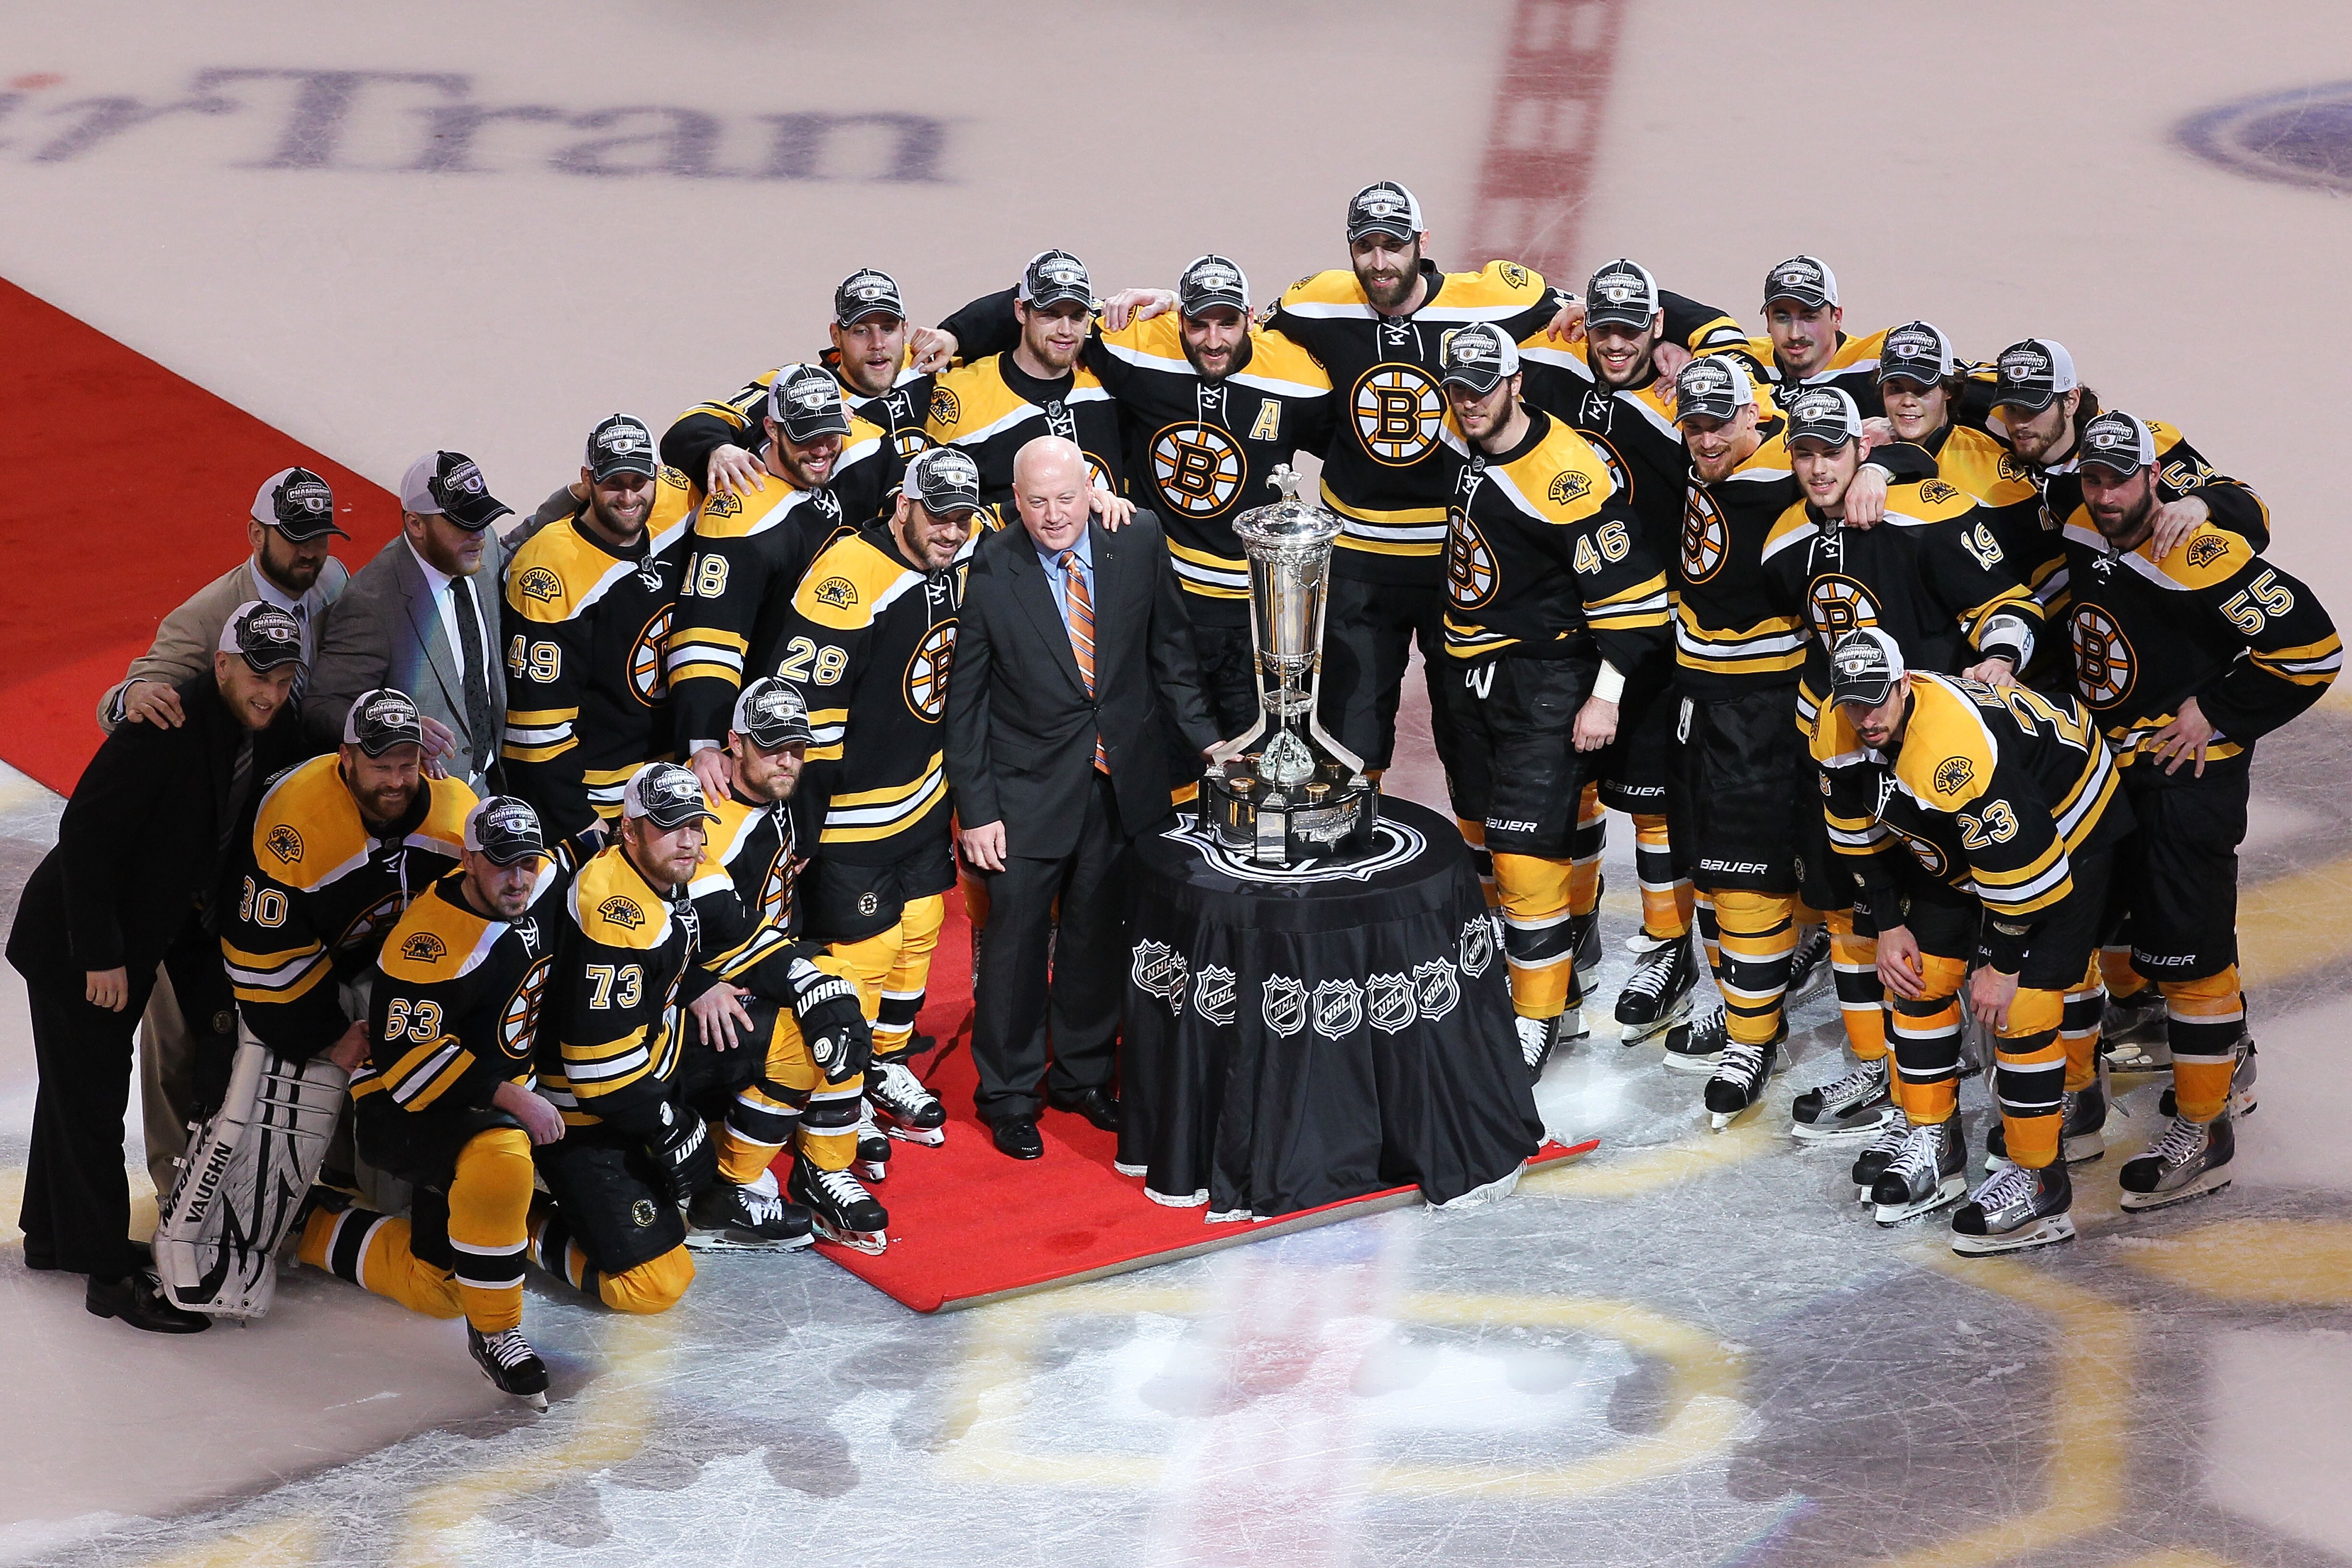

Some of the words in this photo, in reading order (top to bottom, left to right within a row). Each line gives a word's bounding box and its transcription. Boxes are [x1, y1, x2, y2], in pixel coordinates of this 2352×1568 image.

[1359, 196, 1404, 206] CHAMPIONS
[1041, 264, 1084, 275] CHAMPIONS
[1192, 270, 1236, 280] CHAMPIONS
[847, 282, 892, 293] CHAMPIONS
[1598, 280, 1642, 289] CHAMPIONS
[1452, 340, 1494, 349] CHAMPIONS
[1890, 336, 1933, 346] CHAMPIONS
[2003, 357, 2045, 367] CHAMPIONS
[1683, 372, 1725, 384] CHAMPIONS
[790, 384, 833, 398] CHAMPIONS
[933, 391, 956, 417] BRUINS
[1794, 399, 1837, 412] CHAMPIONS
[1249, 398, 1282, 441] A
[1375, 387, 1421, 444] B
[600, 432, 644, 443] CHAMPIONS
[2087, 426, 2131, 436] CHAMPIONS
[1168, 440, 1221, 499] B
[1553, 474, 1586, 495] BRUINS
[1681, 500, 1708, 563] B
[1448, 525, 1474, 589] B
[1573, 520, 1630, 575] 46
[1961, 522, 2004, 572] 19
[2191, 537, 2223, 561] BRUINS
[523, 571, 556, 591] BRUINS
[680, 551, 730, 599] 18
[820, 581, 854, 599] BRUINS
[2219, 568, 2294, 636] 55
[508, 634, 561, 683] 49
[776, 636, 849, 686] 28
[1836, 649, 1880, 660] CHAMPIONS
[2078, 624, 2109, 690] B
[369, 705, 413, 716] CHAMPIONS
[760, 698, 802, 708] CHAMPIONS
[1938, 760, 1967, 788] BRUINS
[491, 811, 534, 821] CHAMPIONS
[1957, 799, 2019, 849] 23
[273, 829, 299, 855] BRUINS
[1700, 858, 1768, 874] BAUER
[239, 875, 288, 928] 30
[604, 899, 640, 919] BRUINS
[406, 936, 441, 952] BRUINS
[1469, 933, 1484, 963] NHL
[1146, 961, 1170, 980] NHL
[586, 964, 644, 1009] 73
[1423, 980, 1445, 1006] NHL
[796, 979, 858, 1017] WARRI
[1209, 989, 1235, 1007] NHL
[1274, 997, 1297, 1017] NHL
[1377, 989, 1403, 1016] NHL
[385, 998, 443, 1043] 63
[1324, 996, 1350, 1024] NHL
[185, 1140, 233, 1223] VAUGHN
